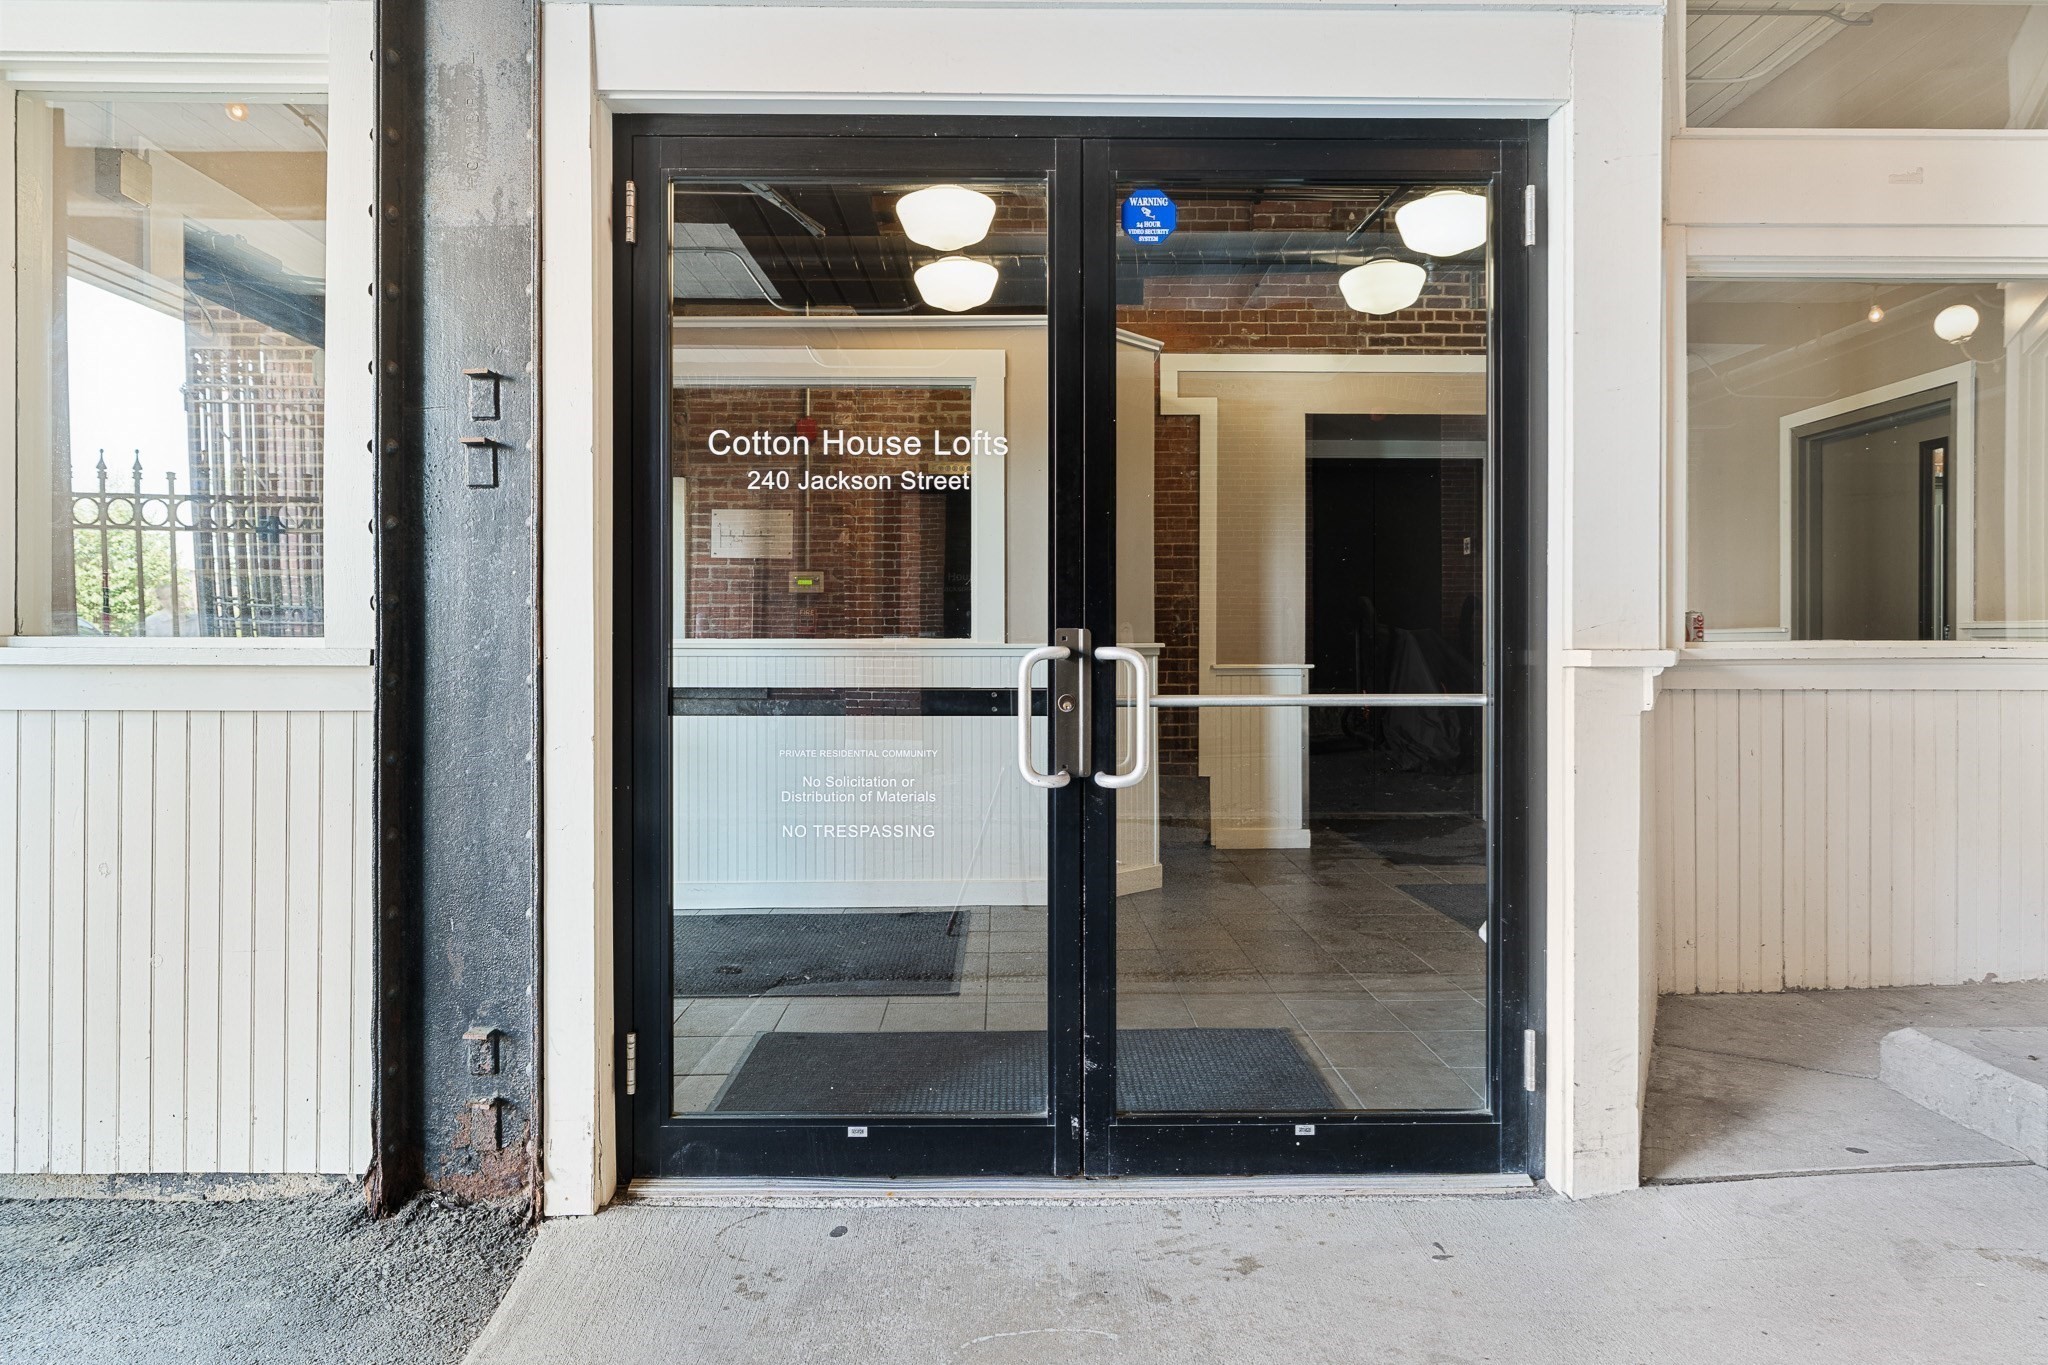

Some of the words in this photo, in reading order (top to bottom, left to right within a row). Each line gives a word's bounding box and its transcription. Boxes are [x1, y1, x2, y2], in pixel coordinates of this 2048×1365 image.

[1129, 197, 1169, 206] WARNING
[708, 429, 809, 456] Cotton
[823, 429, 921, 456] House
[934, 429, 1008, 456] Lofts
[747, 470, 789, 490] 240
[798, 470, 891, 490] Jackson
[901, 470, 970, 490] Street
[779, 750, 817, 758] PRIVATE
[819, 750, 879, 758] RESIDENTIAL
[882, 750, 938, 758] COMMUNITY
[802, 776, 821, 788] No
[825, 776, 897, 788] Solicitation
[901, 778, 915, 788] or
[781, 791, 855, 802] Distribution
[859, 791, 872, 802] of
[877, 791, 936, 802] Materials
[782, 825, 807, 838] NO
[813, 825, 935, 838] TRESPASSING
